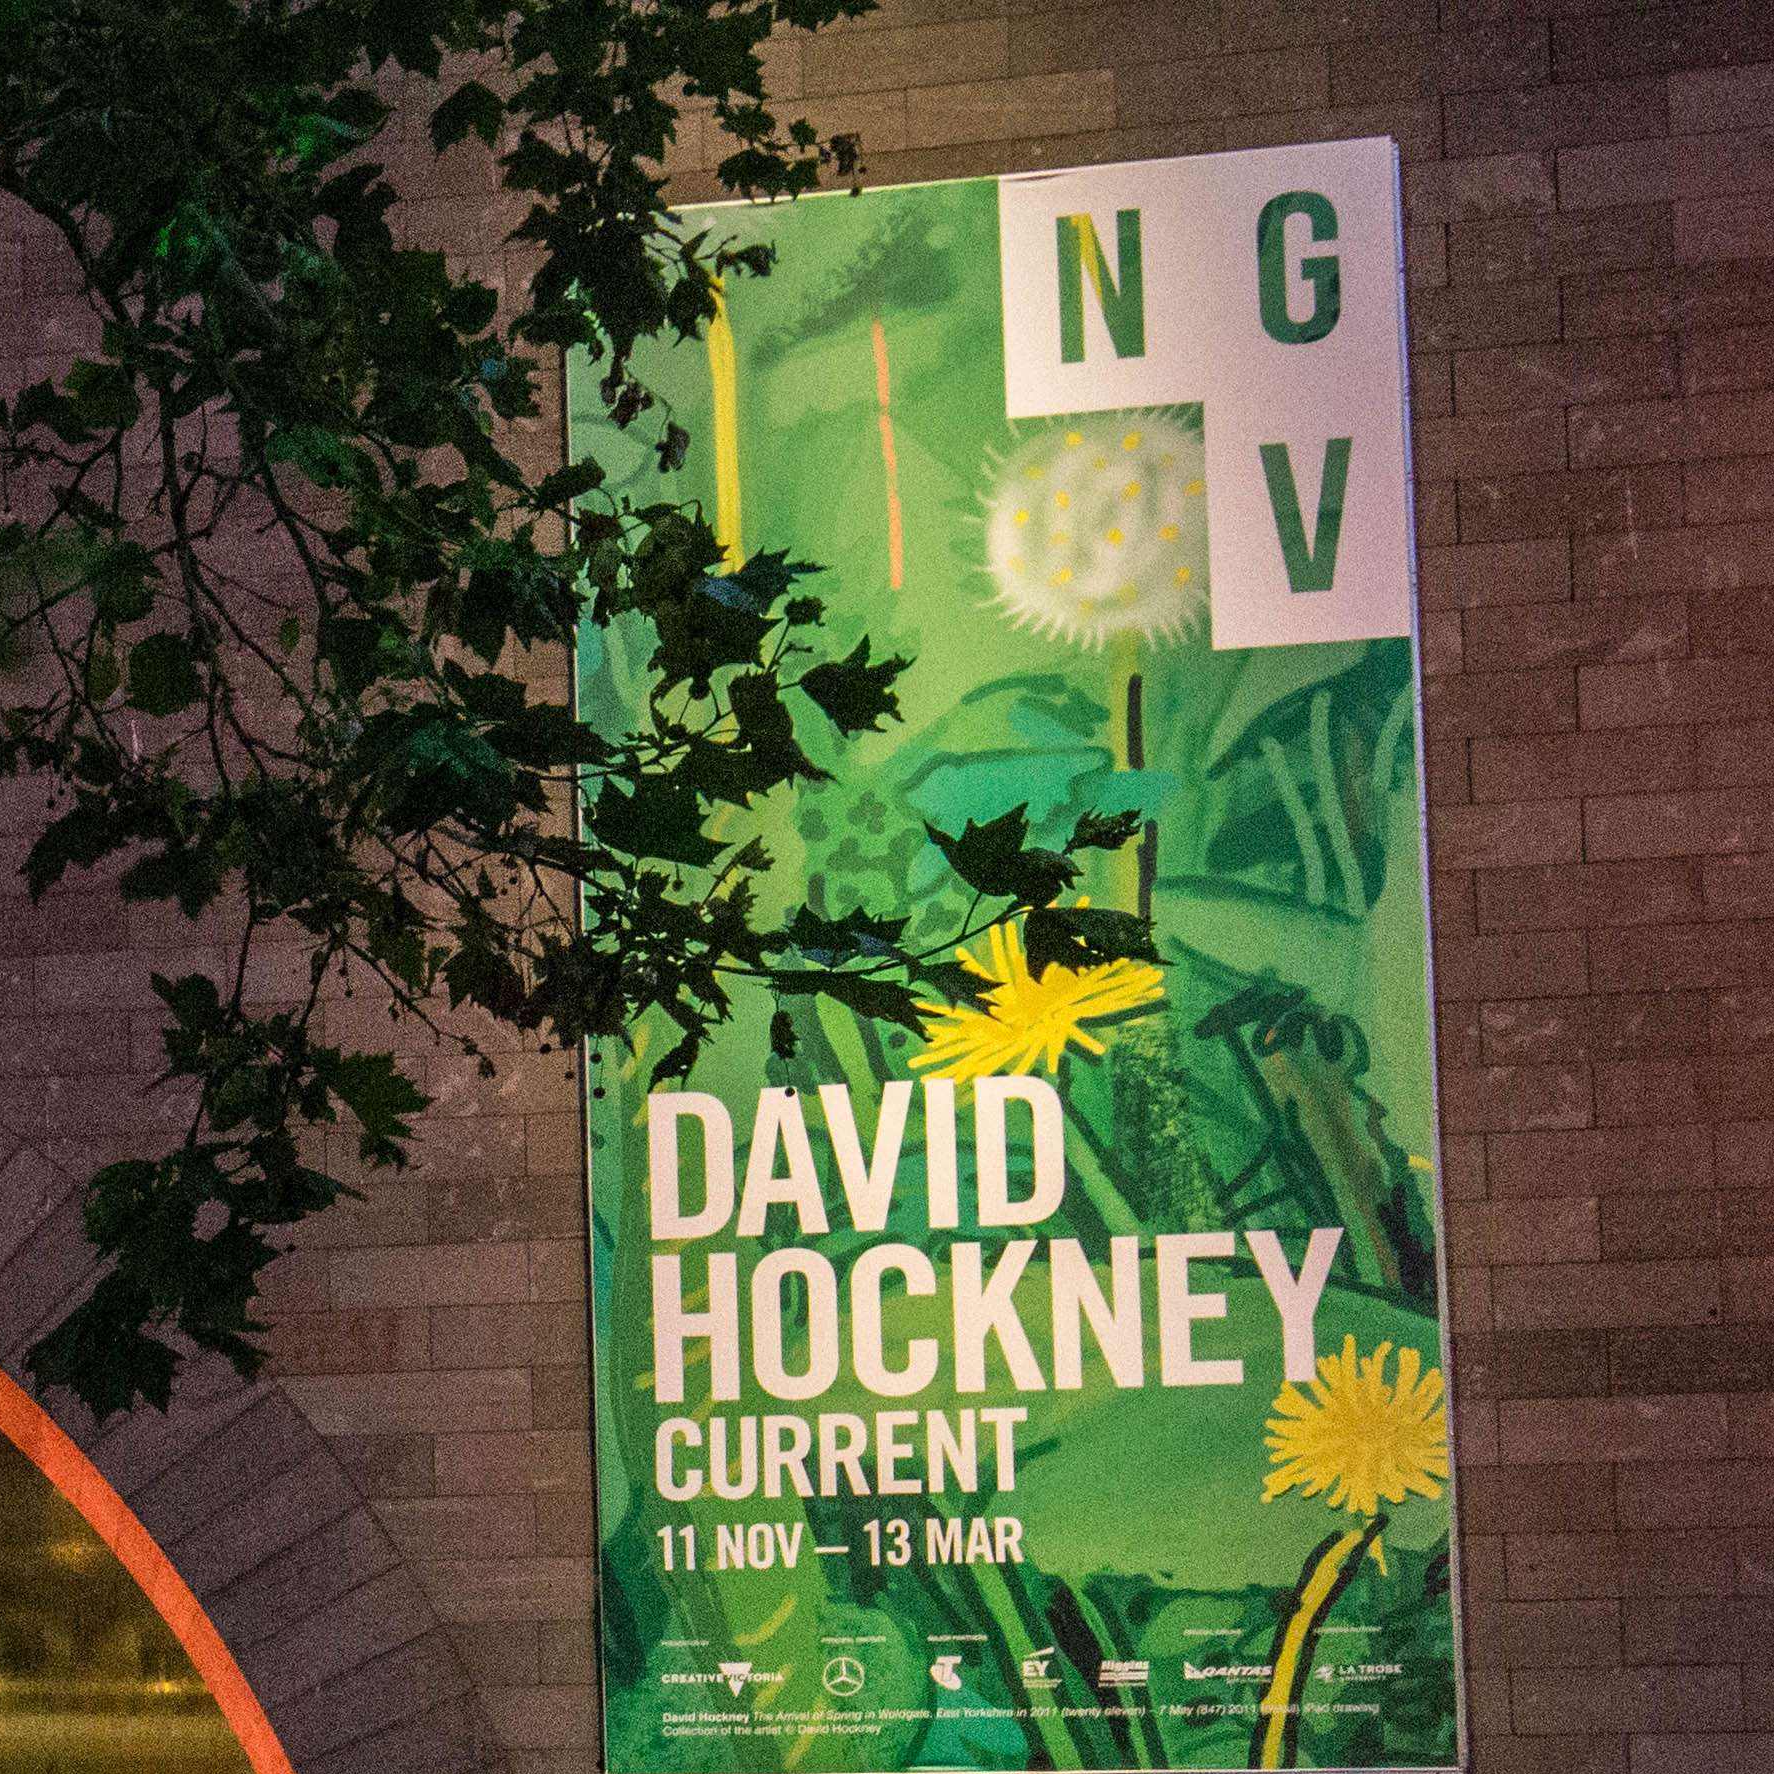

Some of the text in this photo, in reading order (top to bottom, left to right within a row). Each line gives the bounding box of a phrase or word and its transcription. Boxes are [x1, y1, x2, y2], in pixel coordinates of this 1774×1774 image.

[648, 1075, 1066, 1240] DAVID
[652, 1227, 1345, 1403] HOCKNEY
[655, 1406, 1028, 1502] CURRENT
[657, 1524, 697, 1572] 11
[716, 1522, 804, 1570] NOV
[863, 1518, 912, 1566] 13
[926, 1515, 1025, 1565] MAR
[661, 1673, 724, 1684] CREATIVE
[1022, 1660, 1050, 1677] EY
[662, 1712, 695, 1722] David
[699, 1711, 749, 1724] Hockney
